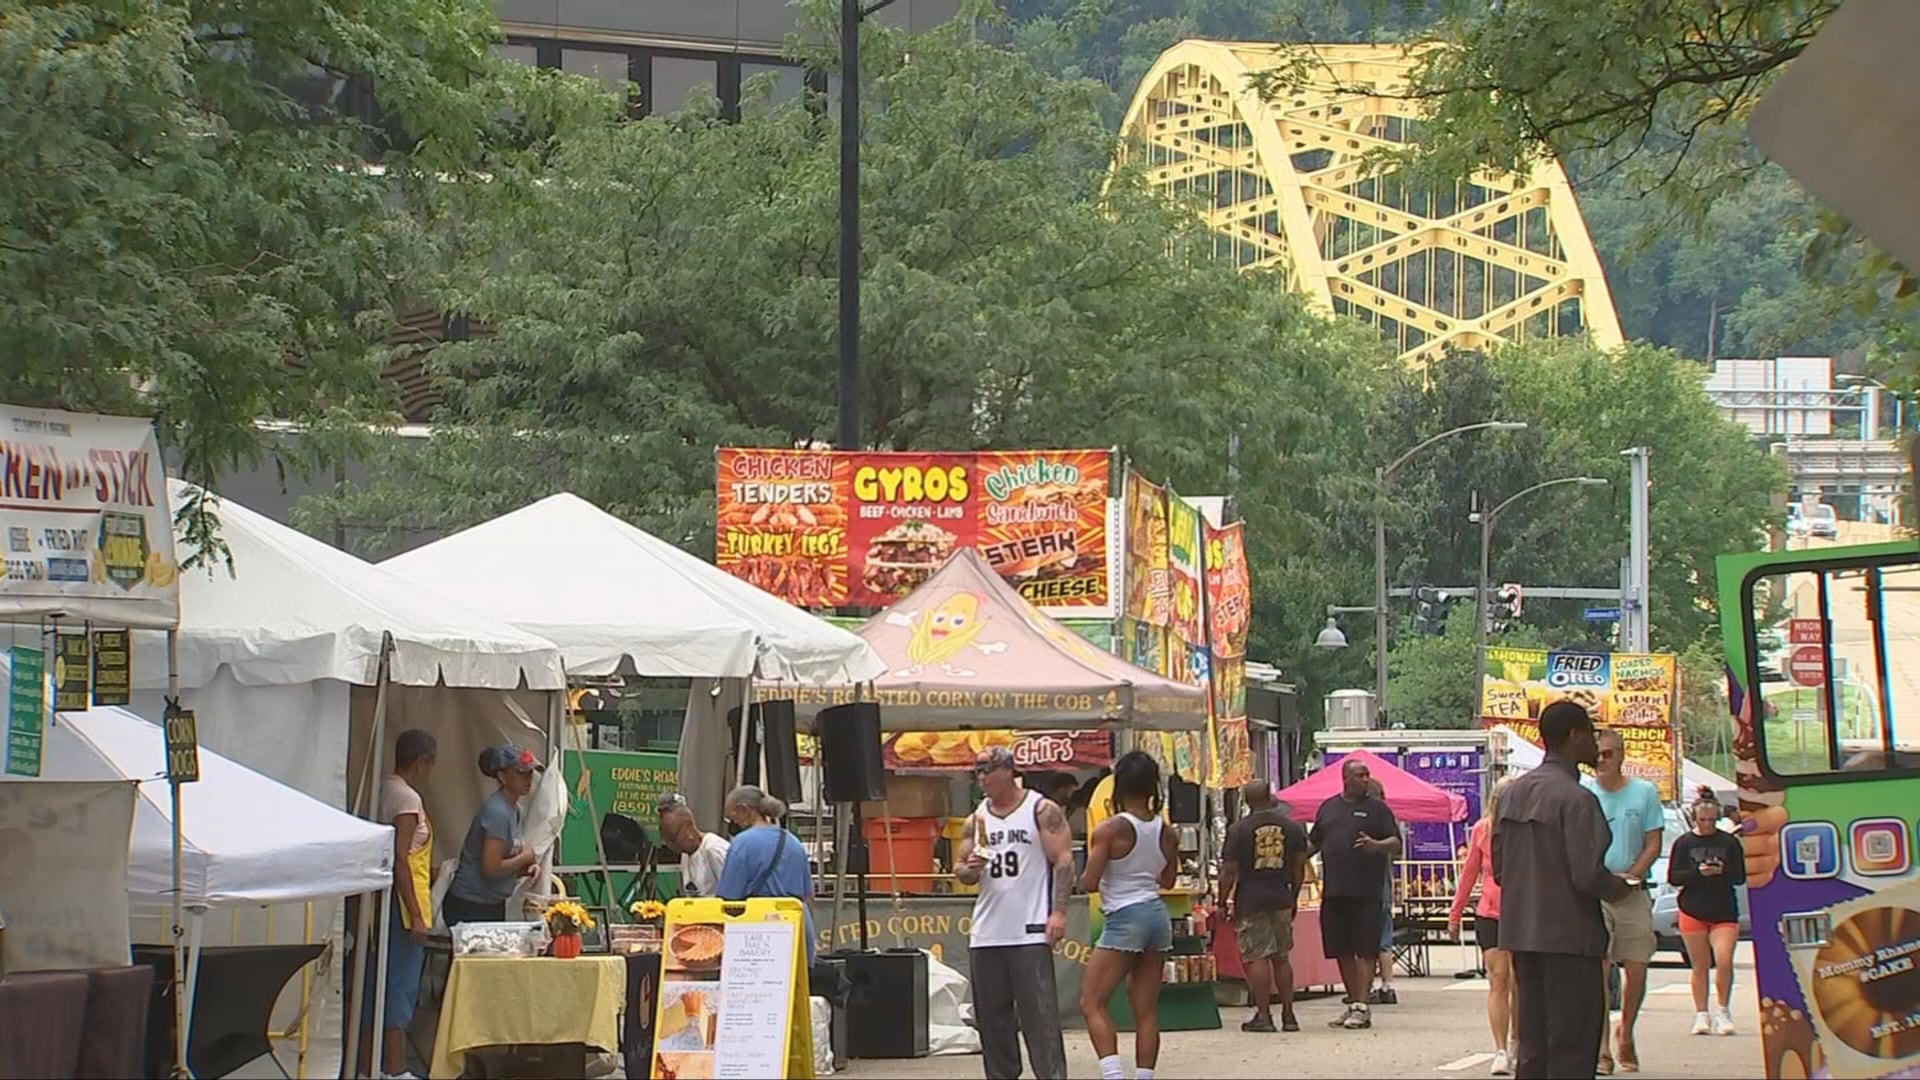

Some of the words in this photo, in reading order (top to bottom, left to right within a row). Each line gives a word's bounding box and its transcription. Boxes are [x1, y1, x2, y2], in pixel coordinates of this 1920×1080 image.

[0, 440, 62, 500] KEN
[732, 455, 832, 479] CHICKEN
[985, 457, 1079, 500] Chicken
[732, 483, 832, 504] TENDERS
[854, 466, 969, 501] GYROS
[860, 506, 885, 518] BEEF
[891, 506, 931, 518] CHICKEN
[987, 501, 1077, 525] Sandwich
[727, 532, 794, 556] TURKEY
[984, 530, 1076, 566] STEAK
[1018, 576, 1099, 600] CHEESE
[1794, 622, 1821, 631] WRON
[1800, 633, 1821, 641] WAY
[1554, 655, 1602, 672] FRIED
[1616, 667, 1665, 679] NACHOS
[1549, 672, 1606, 687] OREO
[756, 688, 827, 705] EDDIE'S
[926, 690, 977, 707] CORN
[980, 692, 1007, 708] ON
[1011, 693, 1049, 709] THE
[1054, 694, 1093, 711] COB
[1487, 688, 1528, 701] Sweet
[1486, 701, 1522, 718] TEA
[167, 718, 194, 744] CORN
[169, 750, 197, 777] DOGS
[611, 767, 652, 782] EDDIE'S
[613, 800, 651, 816] (859)
[989, 831, 1004, 845] SP
[1008, 829, 1033, 845] INC.
[990, 851, 1019, 879] 89
[816, 919, 881, 951] STED
[888, 915, 950, 936] CORN
[958, 916, 973, 936] O
[1817, 954, 1876, 979] Mommy
[1859, 957, 1914, 984] #CAKE
[1870, 1020, 1905, 1039] EST.
